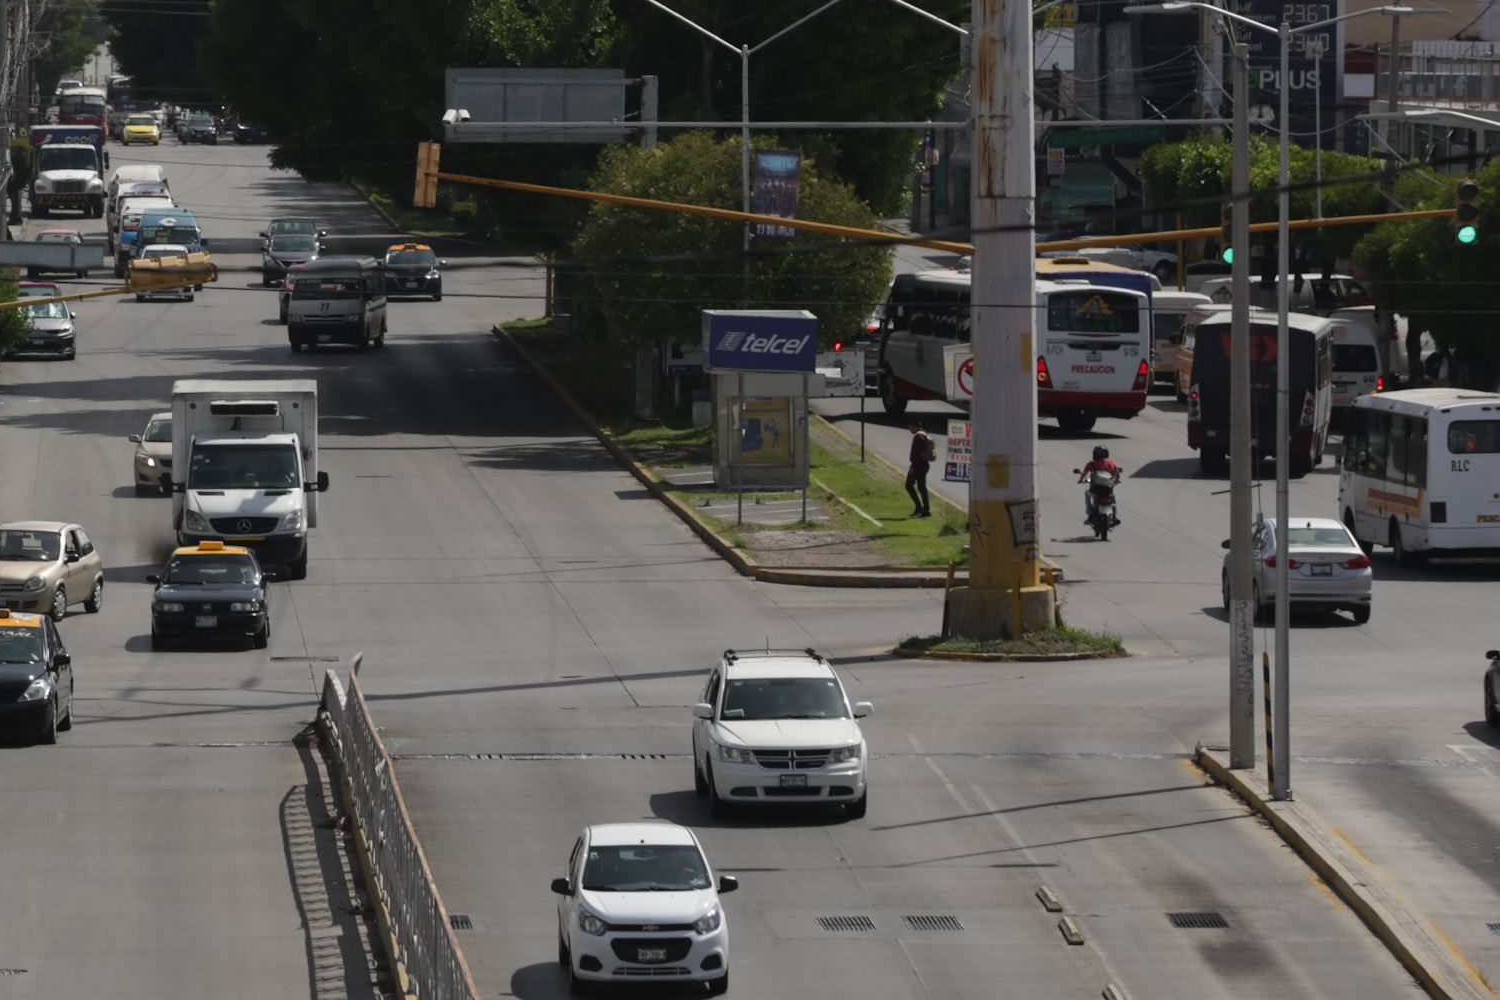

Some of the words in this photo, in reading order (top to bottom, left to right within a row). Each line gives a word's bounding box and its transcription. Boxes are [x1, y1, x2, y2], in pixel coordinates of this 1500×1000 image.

[1259, 70, 1320, 89] PLUS
[740, 332, 810, 354] telcel
[1071, 365, 1116, 374] PRECAUCION
[1451, 460, 1470, 472] RLC
